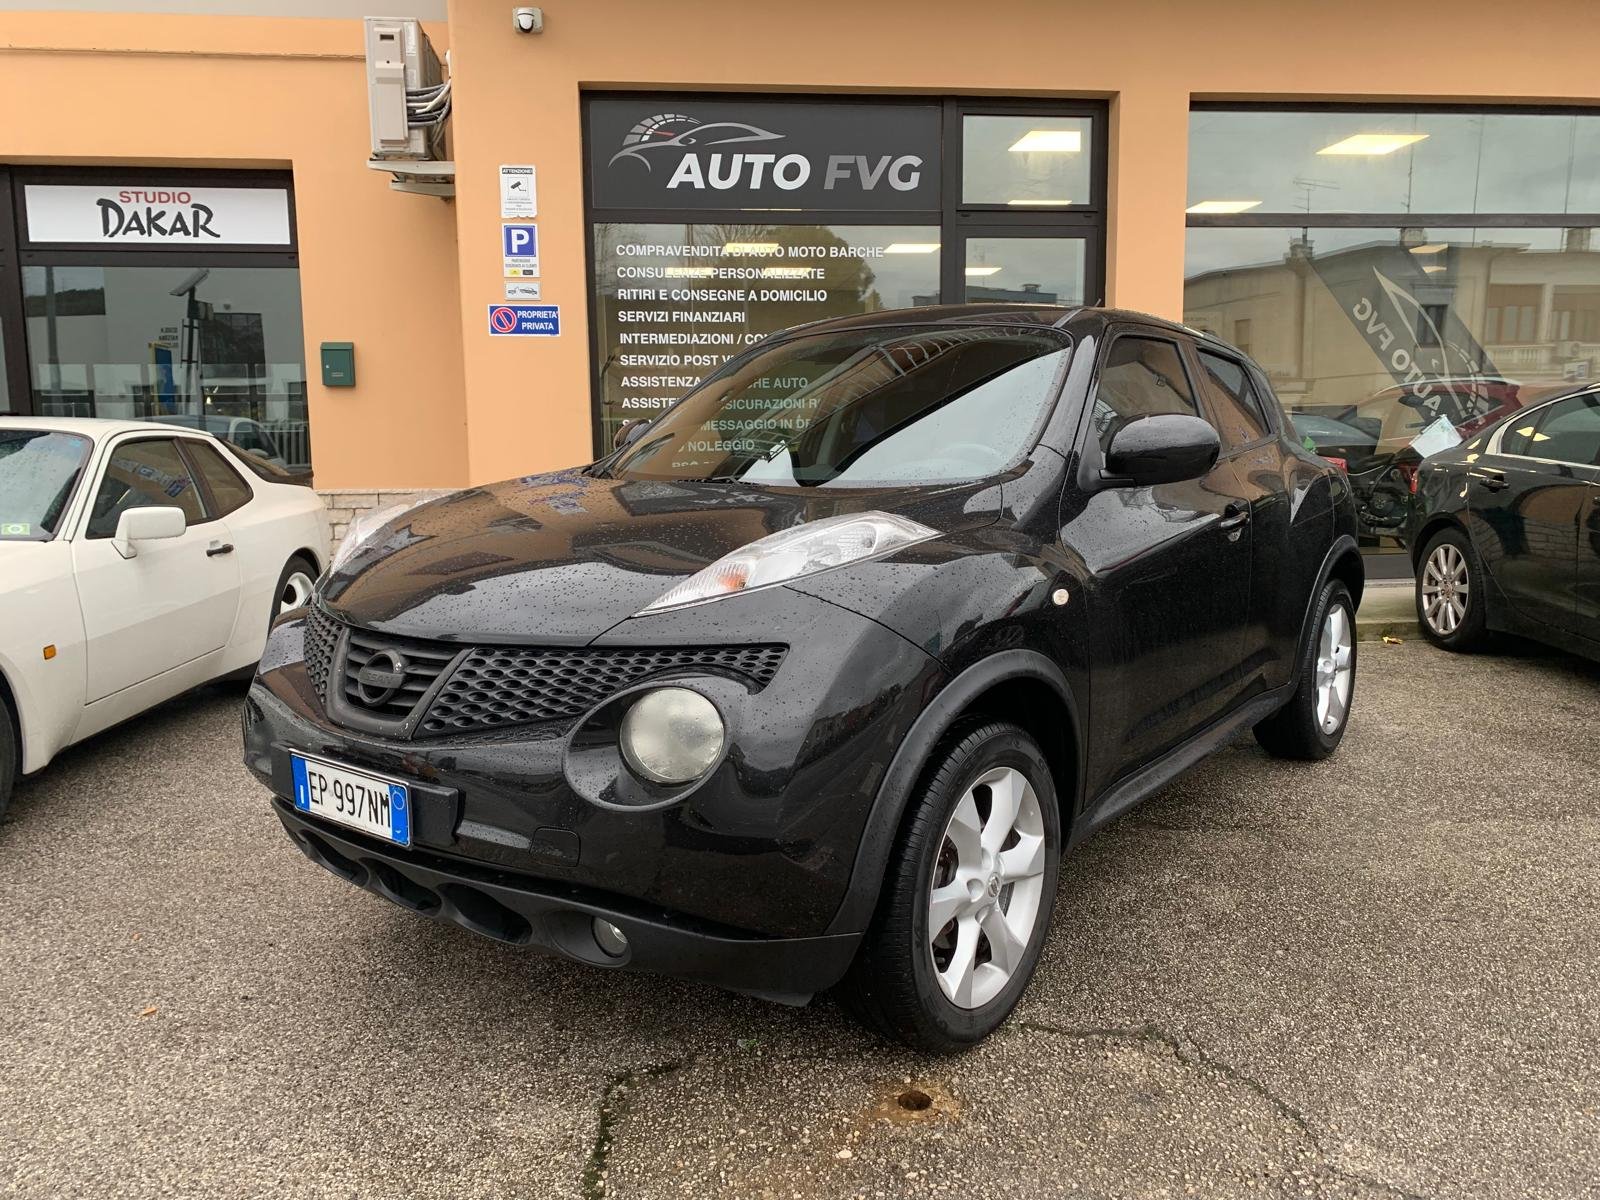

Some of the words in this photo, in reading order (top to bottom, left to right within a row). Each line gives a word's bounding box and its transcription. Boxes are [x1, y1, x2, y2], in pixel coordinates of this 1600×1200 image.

[666, 152, 811, 190] AUTO
[823, 154, 924, 192] FVG
[119, 190, 192, 204] STUDIO
[96, 198, 221, 239] DAKAR
[510, 229, 530, 254] P
[615, 244, 729, 257] COMPRAVENDITA
[748, 245, 785, 258] AUTO
[788, 246, 827, 258] MOTO
[829, 246, 884, 259] BARCHE
[616, 266, 708, 279] CONSULENZE
[710, 267, 826, 280] PERSONALIZZATE
[617, 288, 656, 301] RITIRI
[659, 289, 668, 301] E
[671, 289, 745, 301] CONSEGNE
[747, 289, 758, 301] A
[760, 289, 828, 302] DOMICILIO
[617, 310, 669, 323] SERVIZI
[672, 311, 746, 323] FINANZIARI
[521, 322, 554, 331] PRIVATA
[619, 333, 734, 345] INTERMEDIAZIONI
[619, 354, 680, 366] SERVIZIO
[684, 355, 719, 366] POST
[620, 376, 702, 388] ASSISTENZA
[773, 377, 808, 389] AUTO
[621, 397, 681, 409] ASSISTE
[720, 399, 805, 410] SICURAZIONI
[780, 418, 793, 429] IN
[687, 439, 755, 452] NOLEGGIO
[308, 771, 328, 806] EP
[333, 779, 391, 828] 997NM
